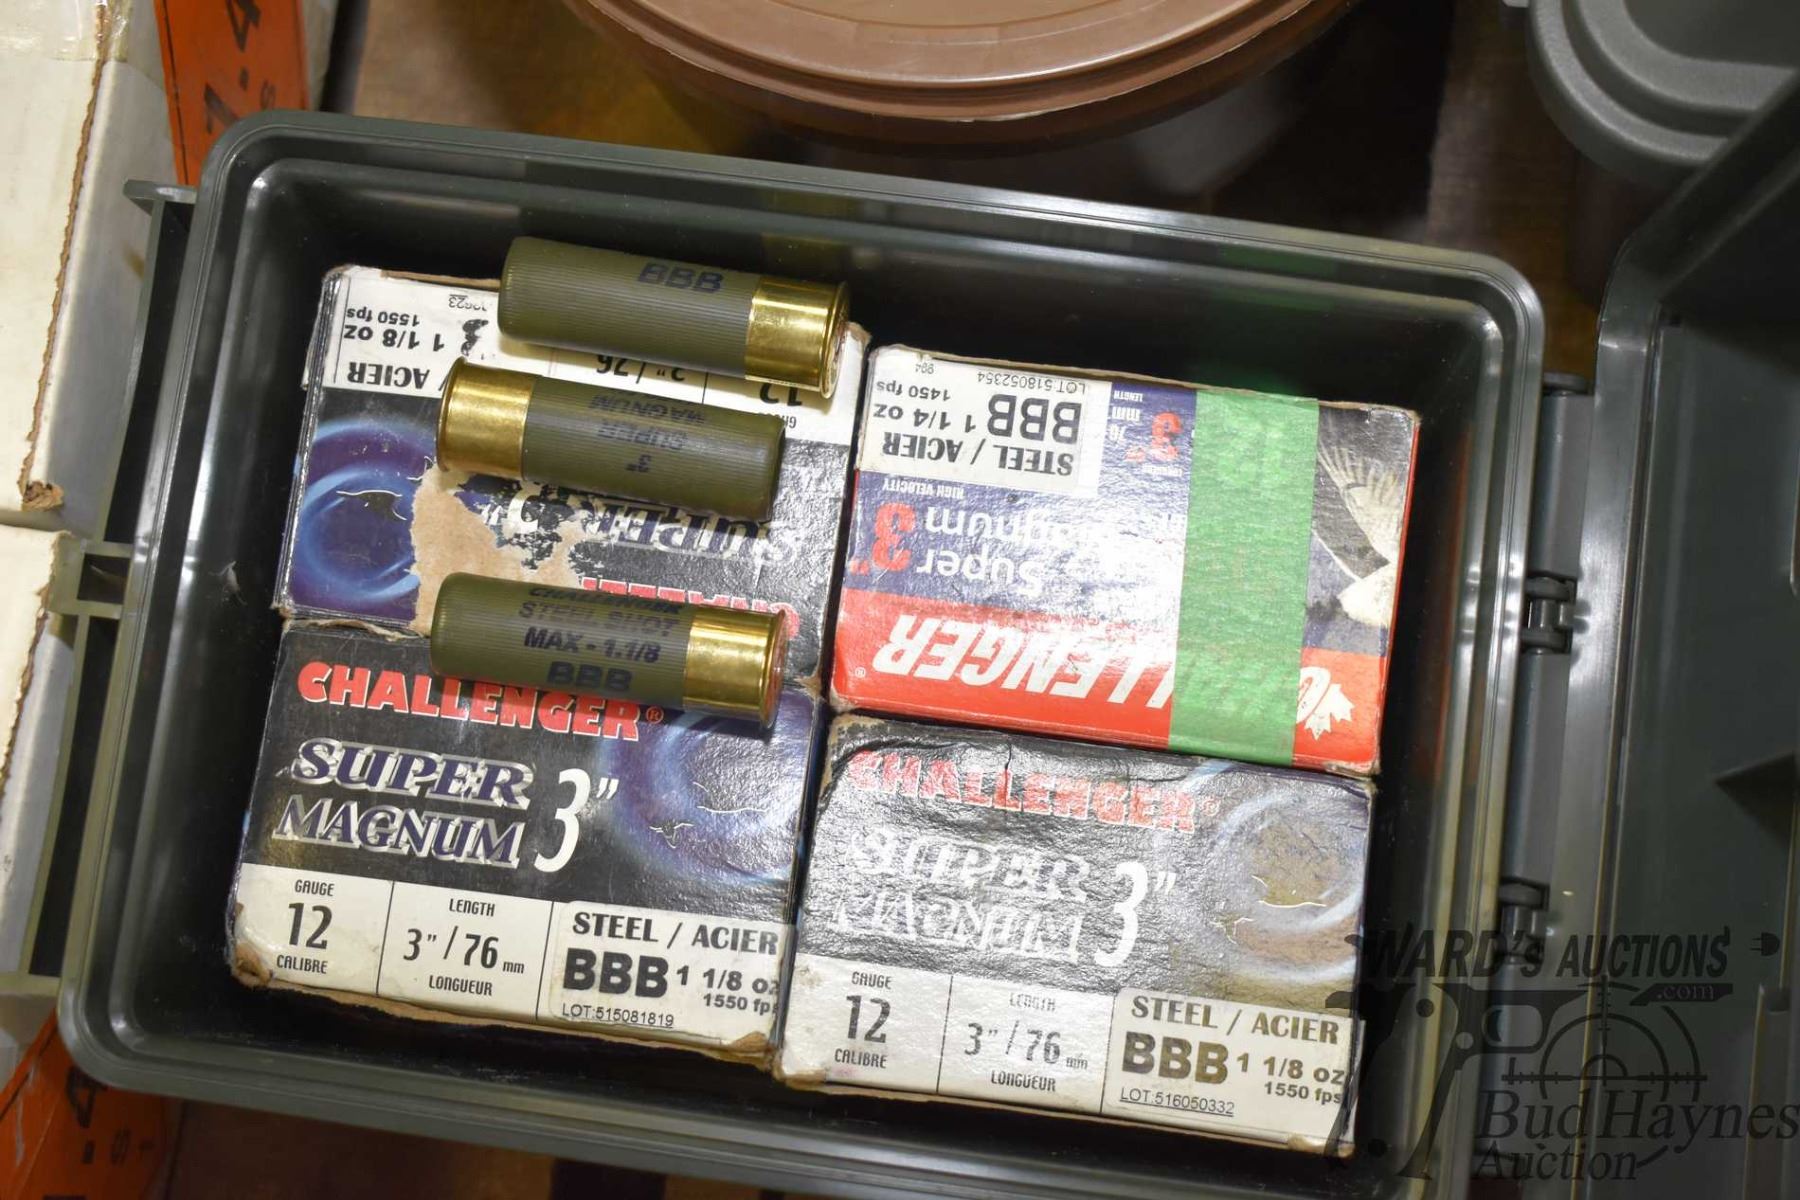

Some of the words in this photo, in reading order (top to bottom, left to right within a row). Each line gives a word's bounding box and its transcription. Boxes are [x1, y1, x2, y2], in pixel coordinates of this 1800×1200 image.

[637, 263, 724, 294] BBB
[346, 306, 373, 323] fps
[378, 310, 421, 328] 1550
[343, 325, 374, 341] oz
[382, 328, 420, 350] 1/8
[347, 362, 430, 390] ACIER
[977, 370, 1086, 395] LOT:518052354
[876, 381, 902, 397] fps
[907, 385, 951, 402] 1450
[873, 403, 904, 420] oz
[913, 408, 951, 431] 1/4
[986, 393, 1082, 445] BBB
[882, 431, 964, 463] ACIER
[992, 444, 1075, 477] STEEL
[882, 477, 934, 496] VELOCITY
[935, 485, 965, 499] HIGH
[916, 546, 1043, 598] Super
[523, 625, 584, 652] MAX
[547, 661, 633, 693] BBB
[298, 661, 641, 742] CHALLENGER
[291, 737, 535, 810] SUPER
[847, 749, 1196, 834] CHALLENGER
[275, 794, 526, 869] MAGNUM
[294, 878, 335, 897] GAUGE
[448, 898, 496, 917] LENGTH
[288, 902, 333, 950] 12
[572, 911, 659, 943] STEEL
[691, 924, 779, 955] ACIER
[276, 953, 329, 975] CALIBRE
[562, 947, 670, 999] BBB
[703, 967, 744, 991] 1/8
[429, 974, 493, 997] LONGUEUR
[851, 970, 893, 990] GAUGE
[702, 992, 748, 1011] 1550
[561, 1003, 675, 1029] LOT:515081819
[845, 995, 891, 1044] 12
[1130, 995, 1218, 1029] STEEL
[1251, 1011, 1339, 1045] ACIER
[834, 1047, 888, 1069] CALIBRE
[1121, 1030, 1229, 1085] BBB
[1263, 1056, 1304, 1080] 1/8
[1313, 1067, 1346, 1086] oz
[990, 1069, 1057, 1092] LONGUEUR
[1264, 1080, 1310, 1100] 1550
[1119, 1086, 1236, 1117] LOT:516050332
